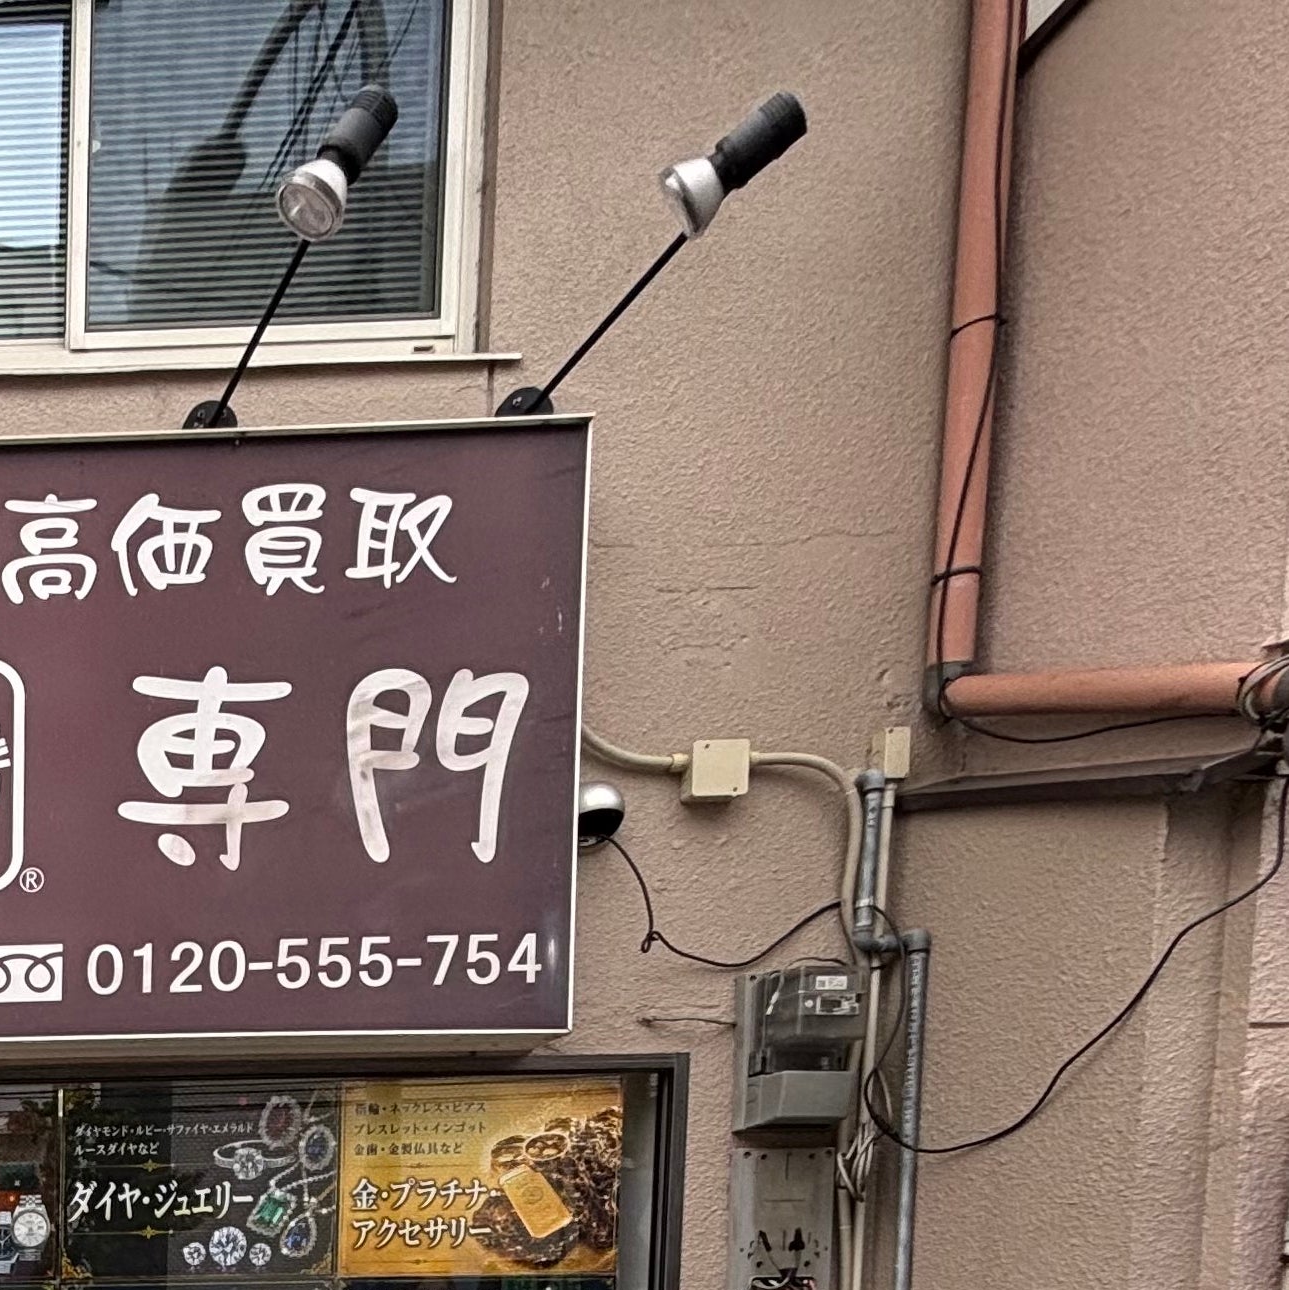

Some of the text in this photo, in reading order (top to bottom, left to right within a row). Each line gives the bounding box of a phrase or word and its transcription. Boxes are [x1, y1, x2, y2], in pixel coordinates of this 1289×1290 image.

[1, 482, 458, 604] 高価買取
[117, 665, 530, 871] 専門
[87, 932, 543, 996] 0120-555-754
[73, 1141, 160, 1156] ルースダイヤなど
[67, 1180, 254, 1223] ダイヤ・ジュエリー
[351, 1217, 492, 1249] アクセサリー
